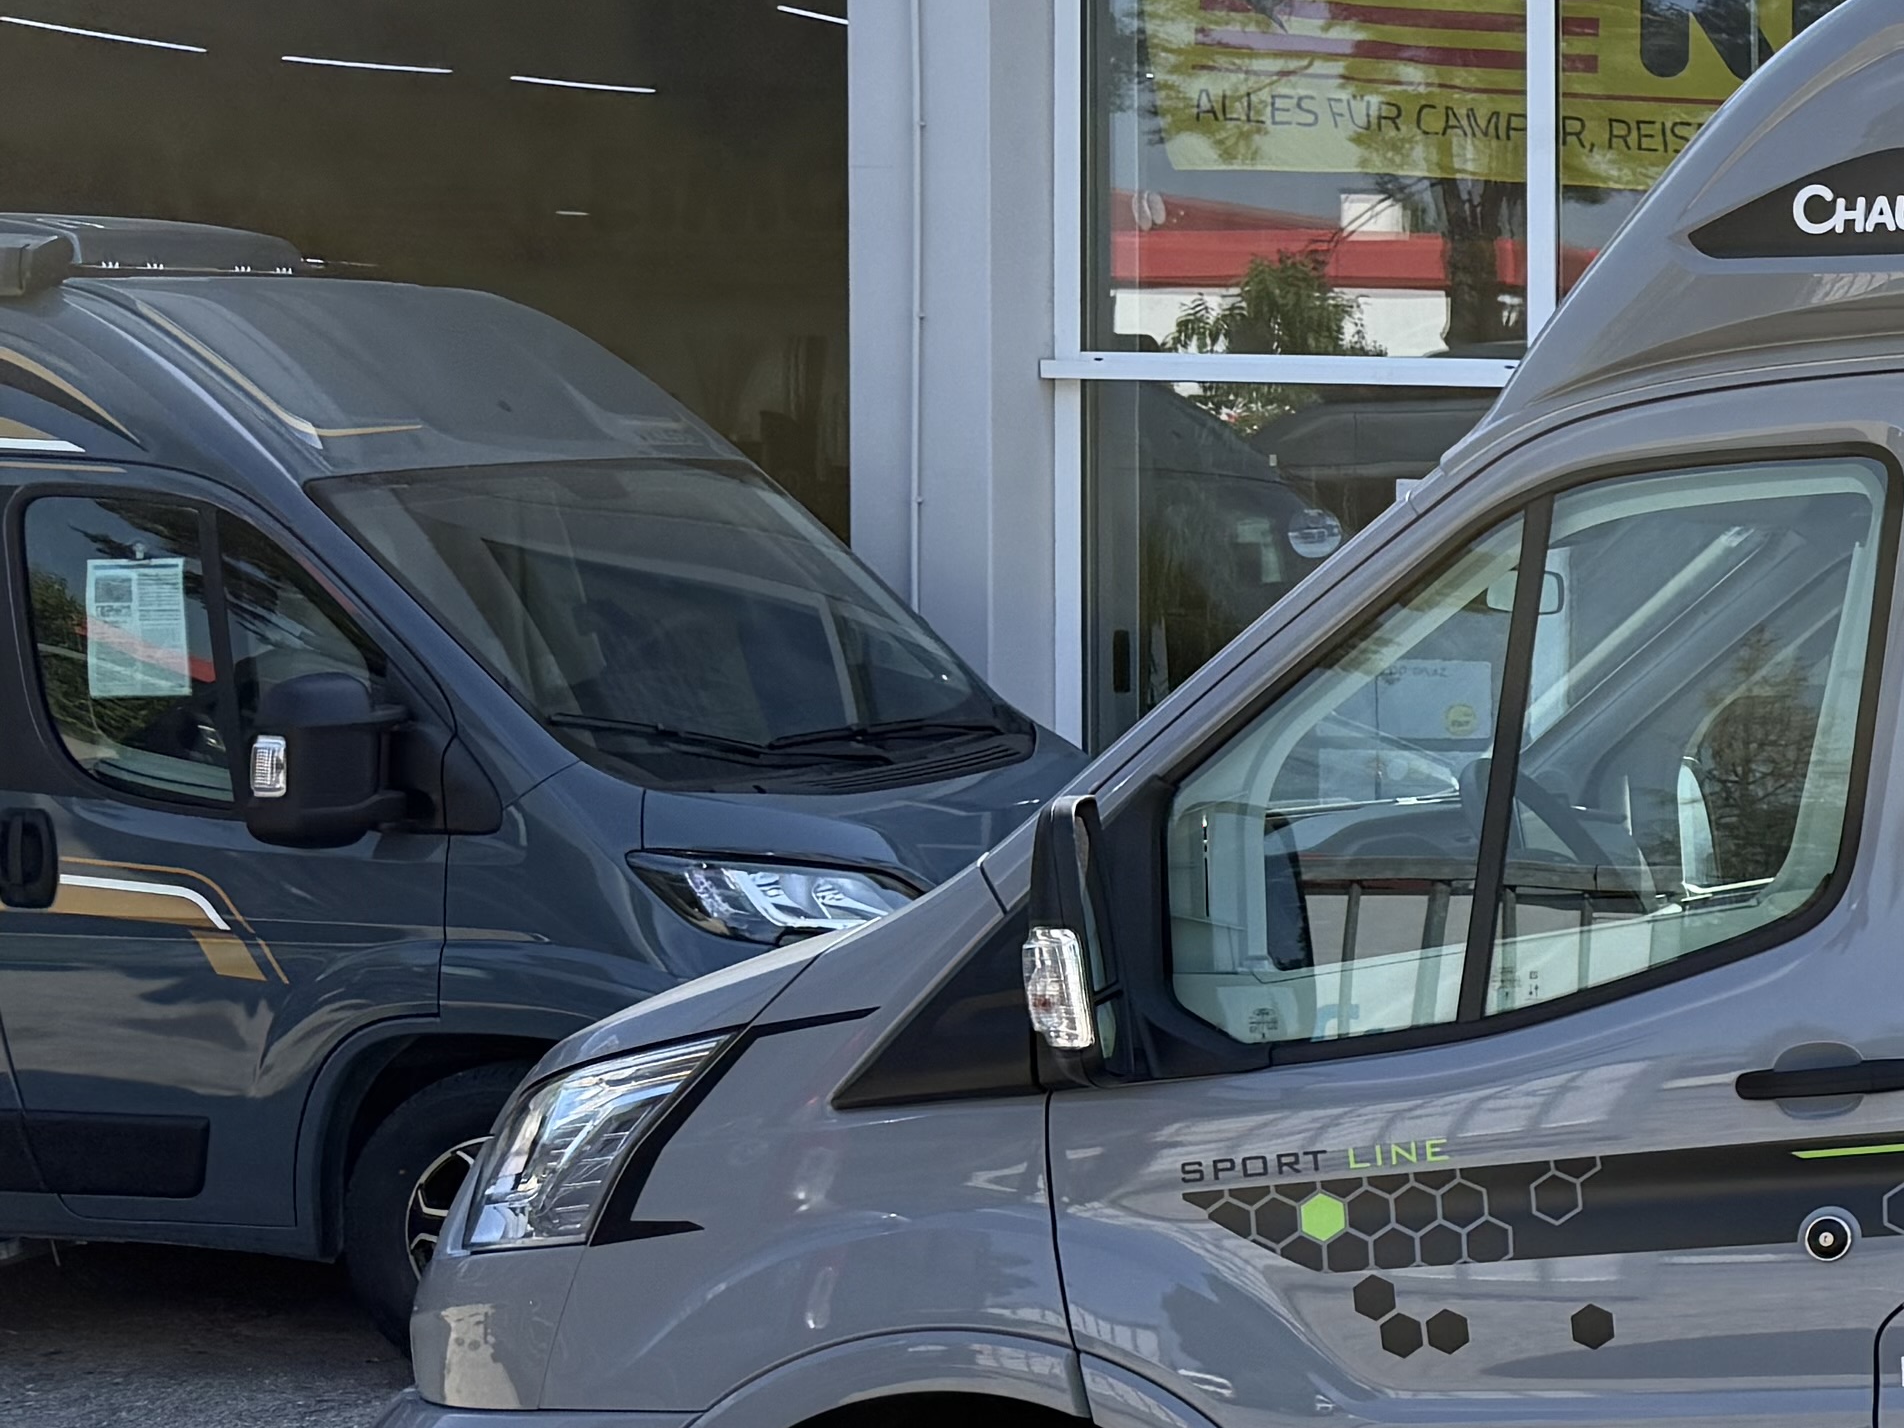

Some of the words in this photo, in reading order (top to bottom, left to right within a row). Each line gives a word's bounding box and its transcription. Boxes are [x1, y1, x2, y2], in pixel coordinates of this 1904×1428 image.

[1195, 88, 1319, 128] ALLES
[1327, 93, 1404, 133] FÜR
[1416, 103, 1595, 154] CAMPR,
[1607, 117, 1704, 154] REIS
[1181, 1149, 1328, 1184] SPORT
[1347, 1138, 1450, 1170] LINE
